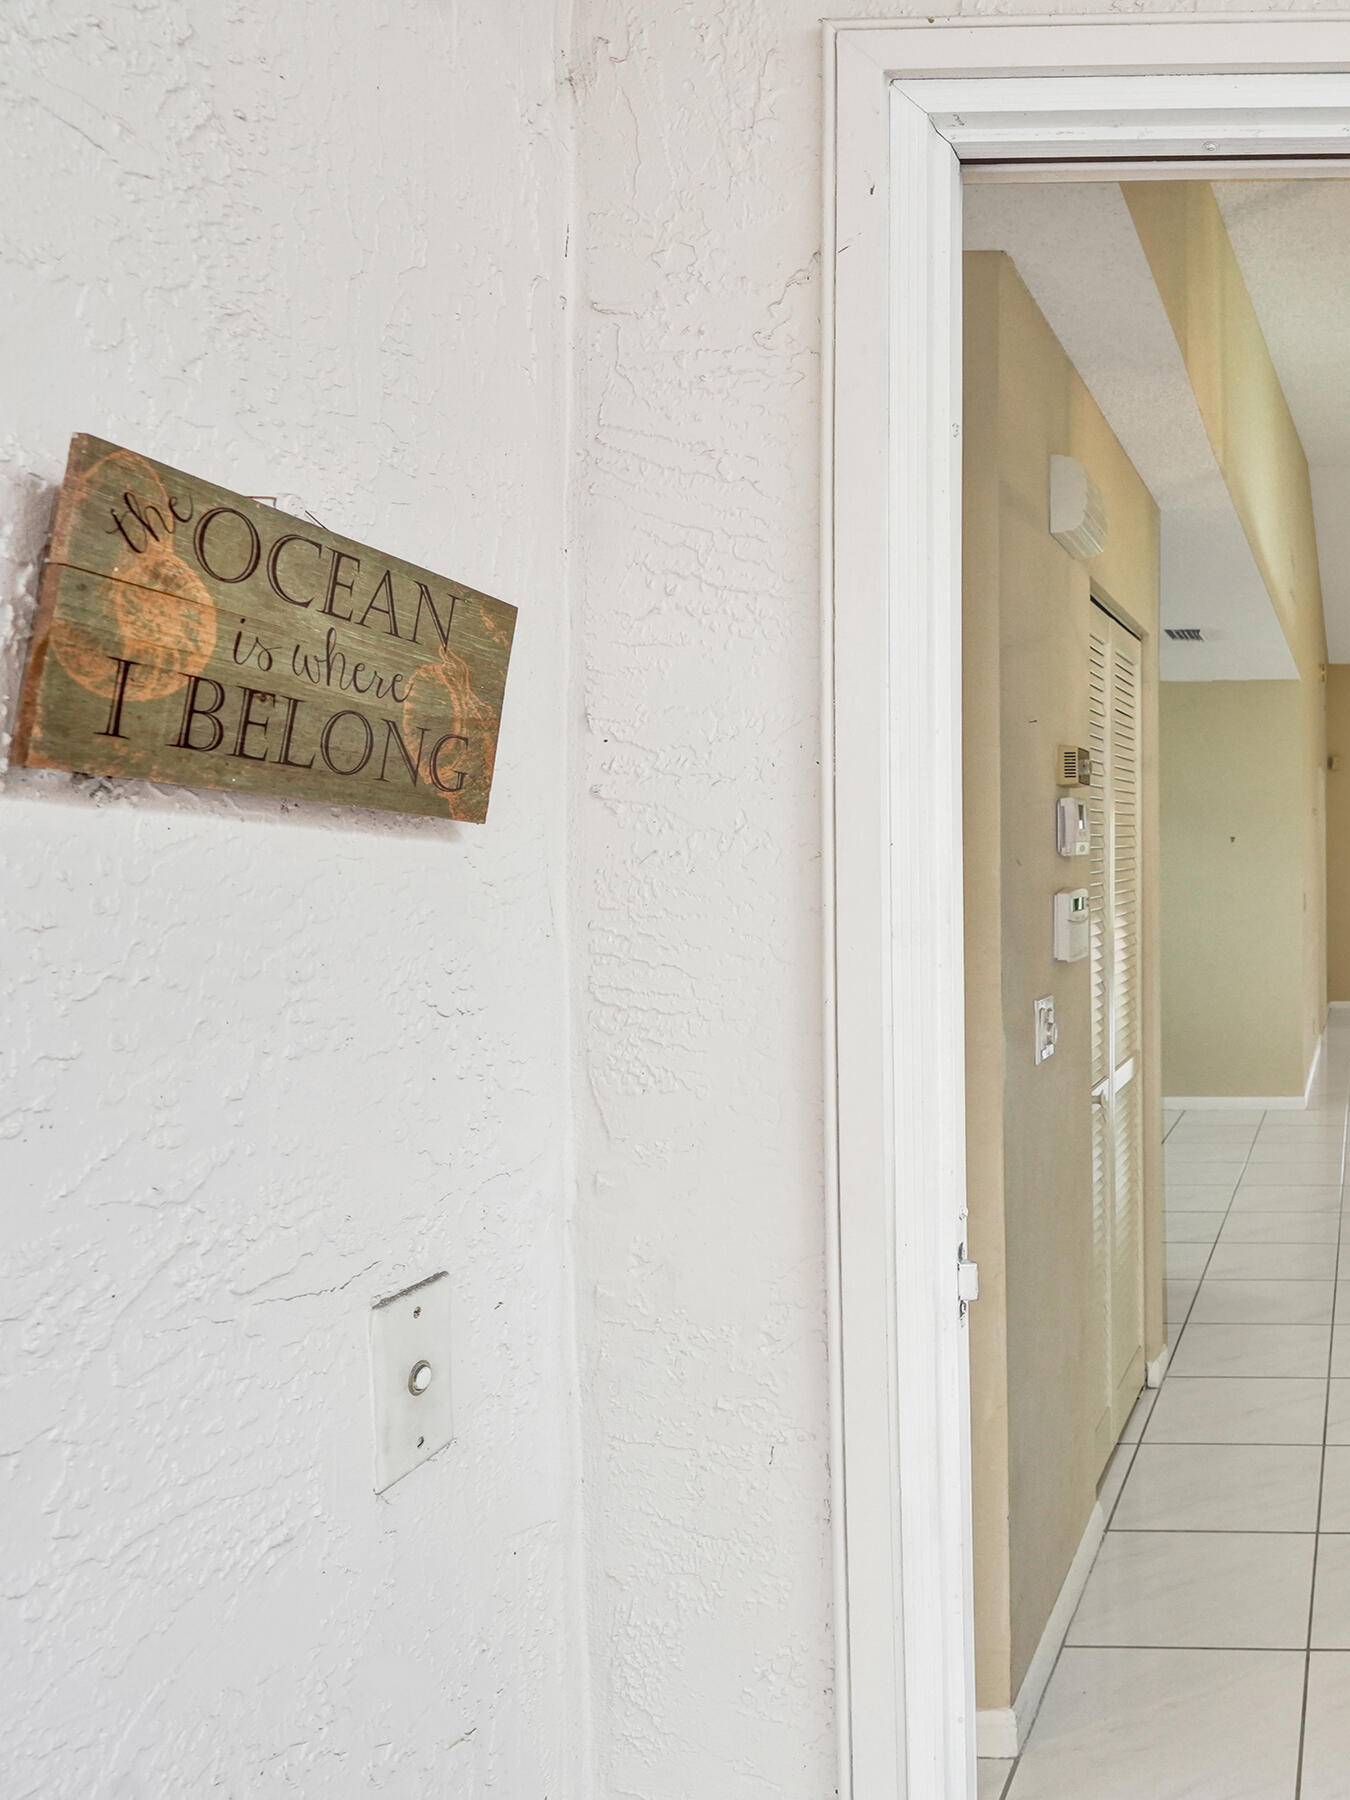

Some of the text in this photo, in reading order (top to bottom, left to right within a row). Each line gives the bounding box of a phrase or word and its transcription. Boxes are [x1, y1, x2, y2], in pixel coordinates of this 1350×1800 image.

[106, 491, 464, 653] the OCEAN
[93, 655, 470, 793] I BELONG
[232, 617, 414, 703] is where
